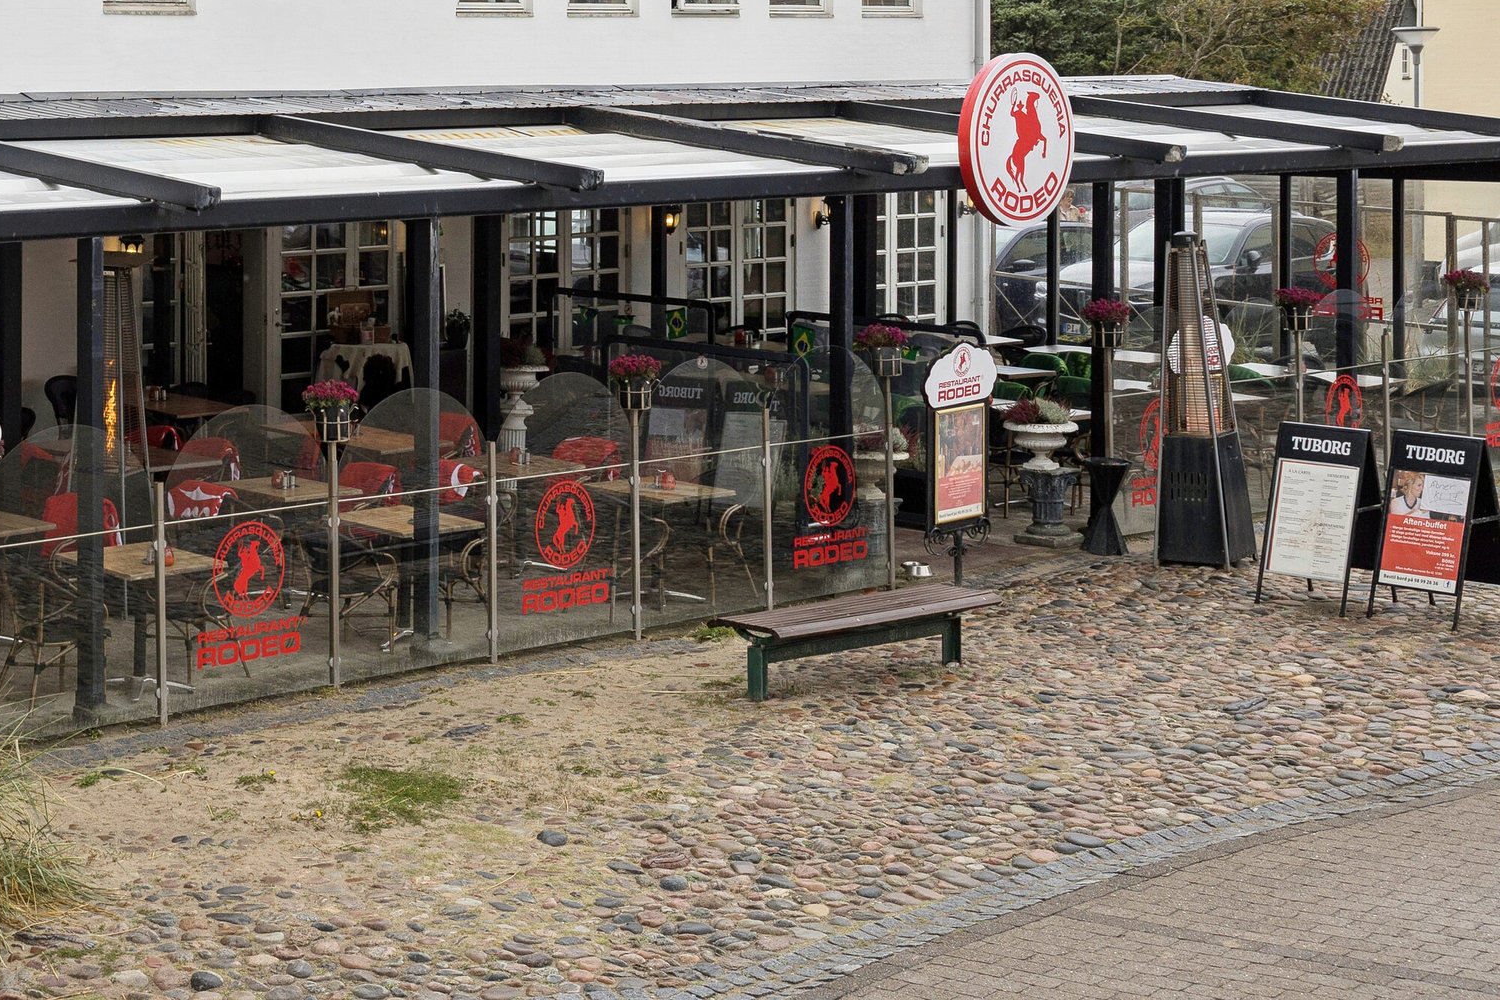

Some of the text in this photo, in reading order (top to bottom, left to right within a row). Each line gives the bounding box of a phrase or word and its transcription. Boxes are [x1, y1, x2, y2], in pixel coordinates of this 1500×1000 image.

[981, 69, 1066, 147] CHURRASQUERIA
[990, 171, 1058, 214] RODEO
[937, 383, 981, 403] RODEO
[938, 375, 981, 390] RESTAURANT
[1291, 436, 1352, 456] TUBORG
[1405, 444, 1466, 465] TUBORG
[811, 501, 848, 522] RODEO
[1402, 517, 1448, 530] Aften-buffet
[793, 527, 867, 548] RESTAURANT
[543, 540, 587, 565] RODEO
[793, 539, 868, 570] RODEO
[522, 568, 608, 592] RESTAURANT
[222, 585, 275, 613] RODEO
[522, 582, 609, 615] RODEO
[196, 616, 300, 645] RESTAURANT
[196, 631, 301, 670] RODEO
